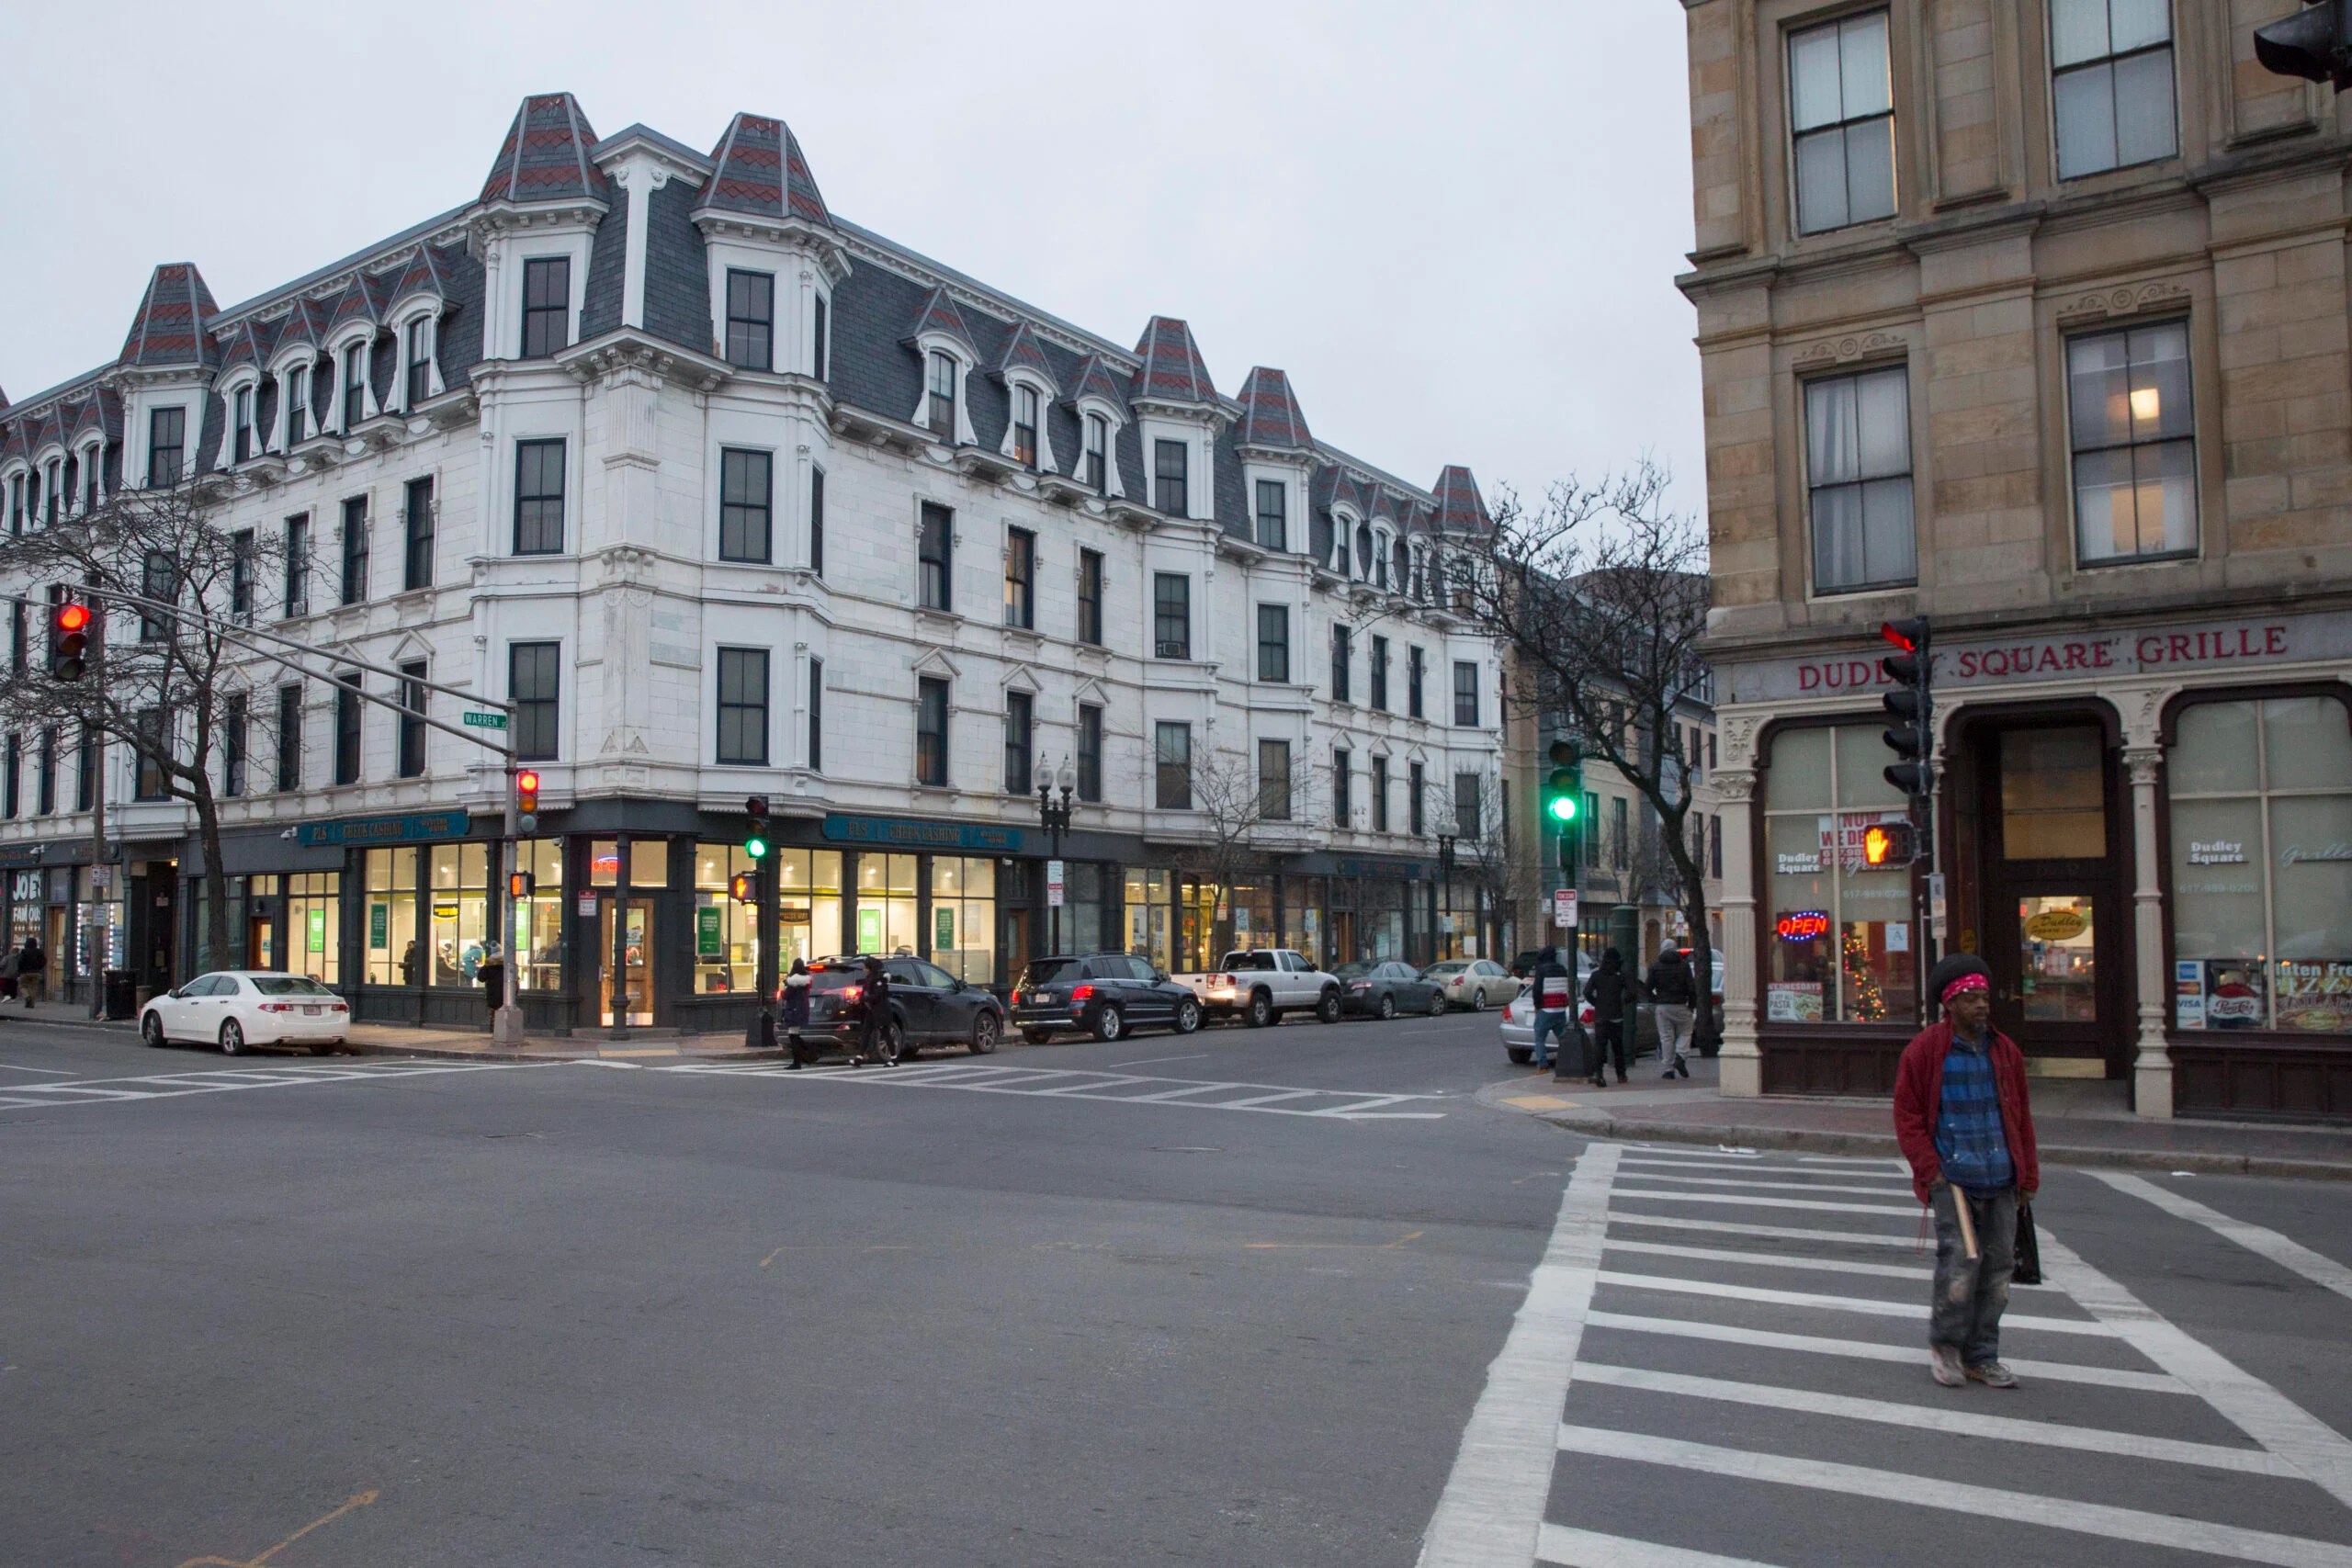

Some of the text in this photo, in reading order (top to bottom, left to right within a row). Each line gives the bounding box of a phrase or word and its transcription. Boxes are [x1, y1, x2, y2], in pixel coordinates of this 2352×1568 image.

[1798, 626, 2289, 690] DUDL SQUARE GRILLE
[465, 714, 498, 727] WARREN
[1843, 813, 1882, 827] NOW
[313, 821, 403, 840] PLS CHECK CASHING
[848, 822, 960, 841] PLS CHECK CASHING
[2191, 840, 2243, 852] Dudley
[1778, 852, 1819, 863] Dudley
[2191, 853, 2244, 864] Square
[591, 860, 618, 873] OPE
[1778, 863, 1820, 874] Square
[1778, 918, 1826, 934] OPEN
[1893, 931, 1904, 941] A
[1770, 999, 1791, 1008] PASTA
[2177, 999, 2201, 1008] VISA
